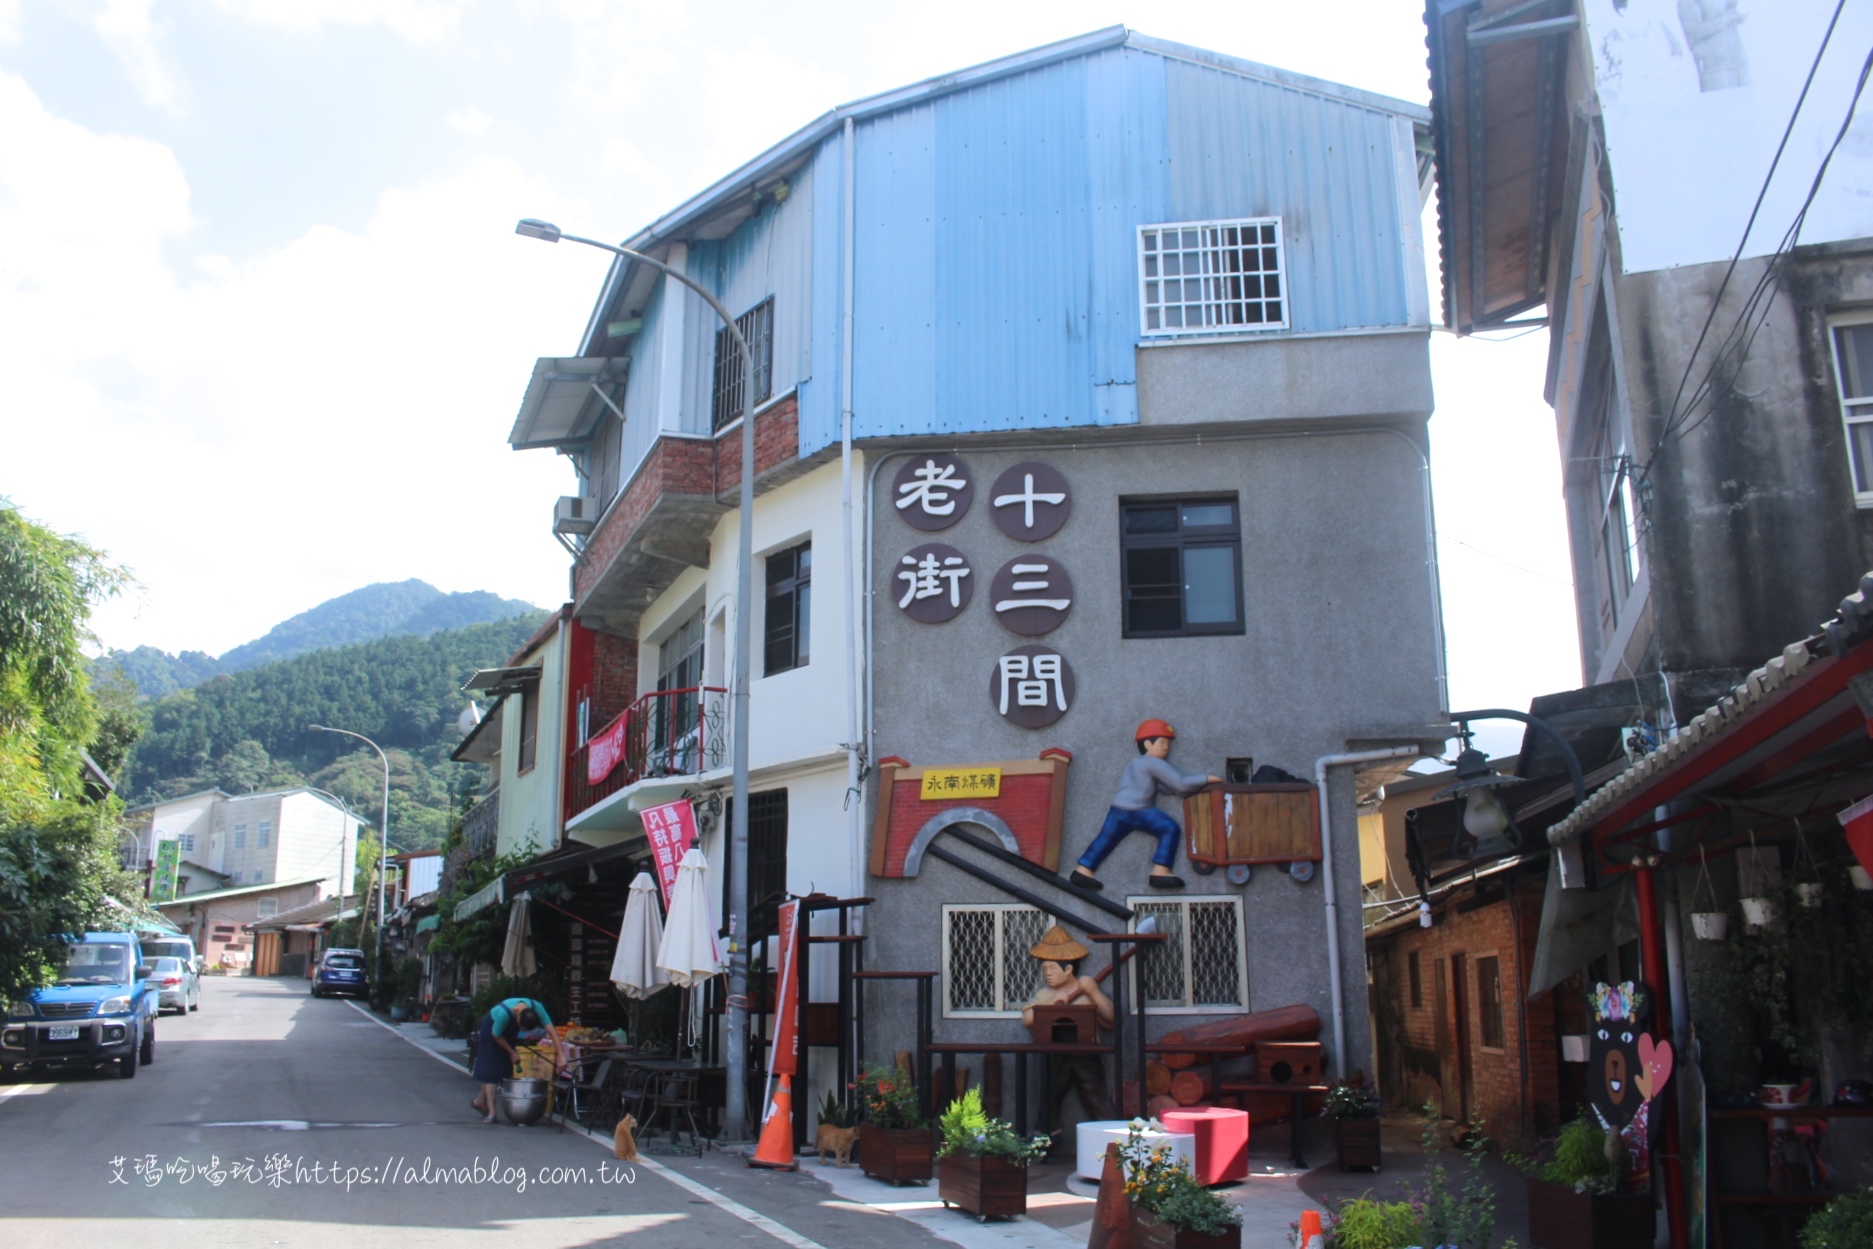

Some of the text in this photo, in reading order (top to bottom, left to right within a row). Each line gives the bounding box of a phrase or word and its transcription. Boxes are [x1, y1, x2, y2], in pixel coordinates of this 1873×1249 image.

[895, 458, 971, 610] 老街
[993, 473, 1073, 716] 十三間
[927, 773, 996, 793] 永南煤礦
